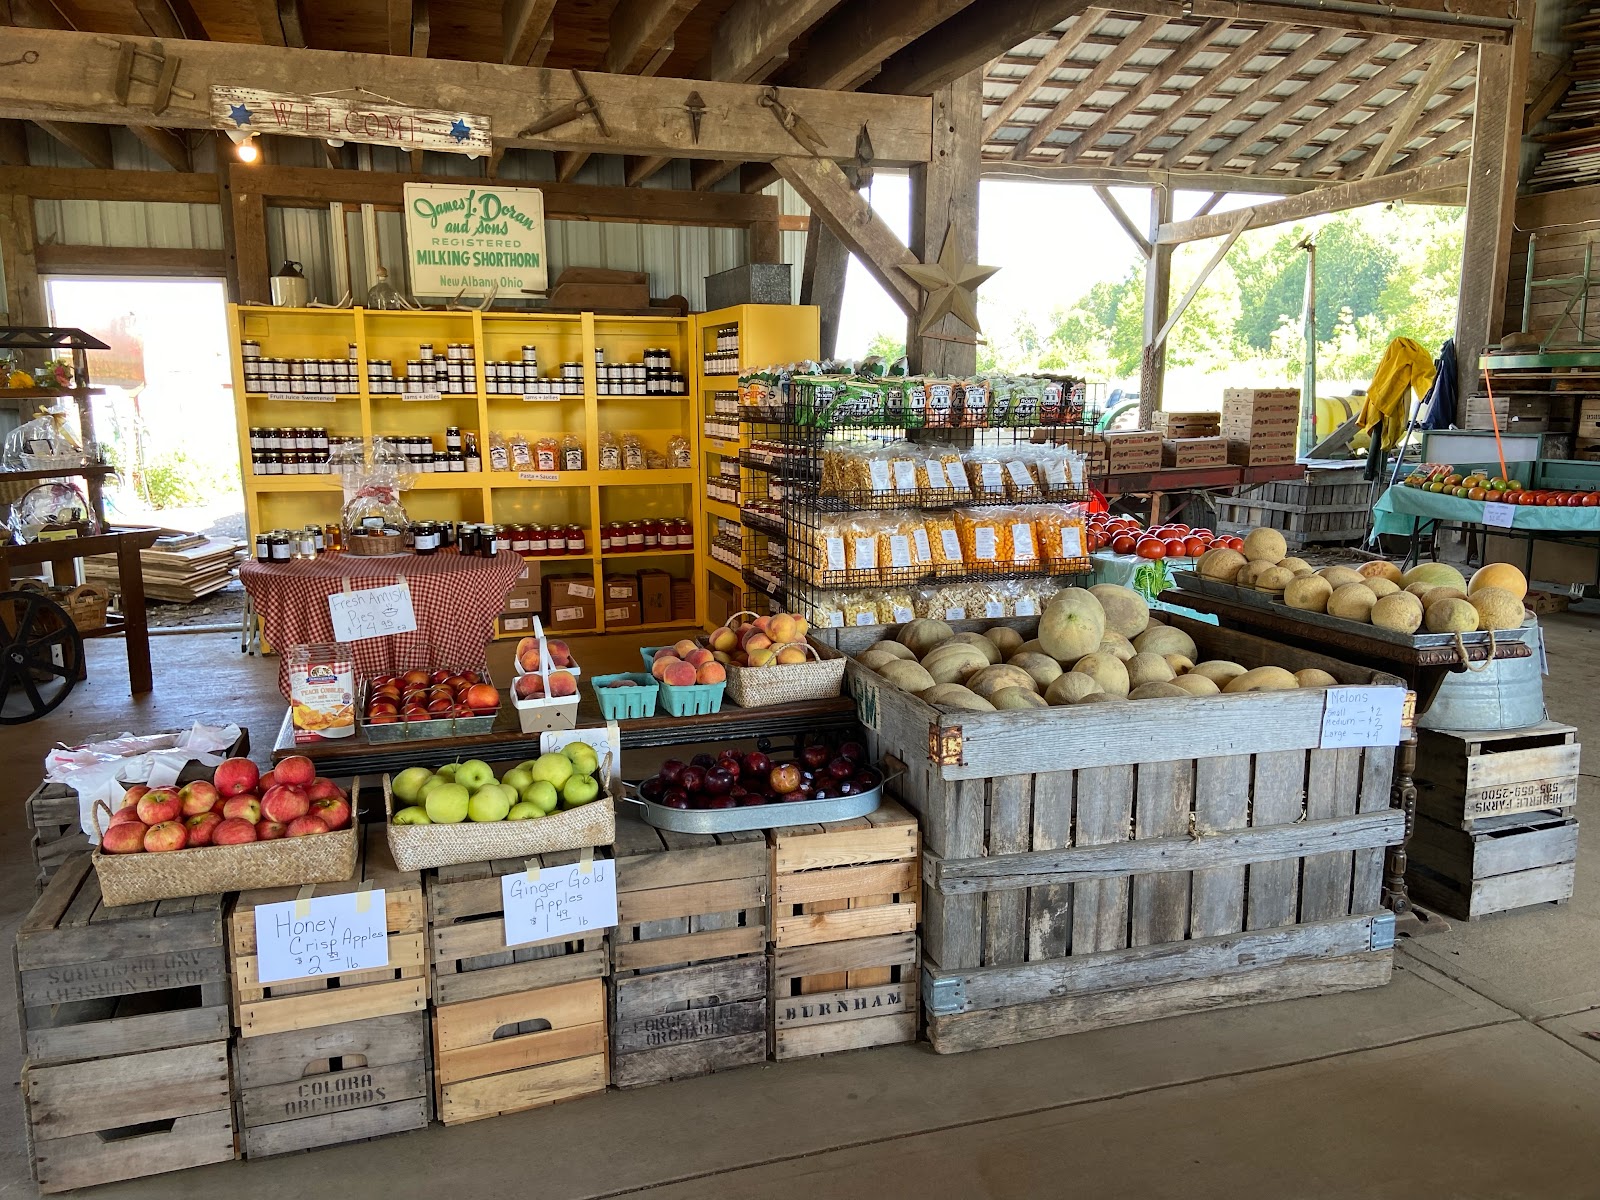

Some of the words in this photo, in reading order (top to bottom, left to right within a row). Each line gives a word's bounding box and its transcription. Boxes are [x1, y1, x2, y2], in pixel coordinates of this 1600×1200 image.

[271, 101, 424, 142] WELCOME
[413, 197, 466, 229] James
[477, 193, 535, 231] Doran
[444, 220, 470, 234] and
[431, 237, 522, 248] REGISTERED
[416, 249, 471, 266] MILKING
[472, 251, 540, 267] SHORTHORN
[440, 275, 460, 287] New
[500, 276, 523, 288] Ohio
[301, 394, 335, 402] Sweetened
[331, 593, 366, 611] Fresh
[369, 588, 409, 605] Amish
[347, 610, 375, 628] Pies
[1331, 689, 1368, 704] Melons
[1325, 718, 1356, 726] Medium
[1475, 799, 1512, 813] FARMS
[510, 880, 563, 899] Ginger
[568, 866, 604, 889] Gold
[534, 891, 583, 913] Apples
[275, 910, 337, 938] Honey
[289, 936, 338, 956] Crisp
[342, 926, 384, 950] Apples
[785, 991, 902, 1021] BURNHAM
[298, 1073, 373, 1098] COLORA
[284, 1086, 387, 1116] ORCHARDS
